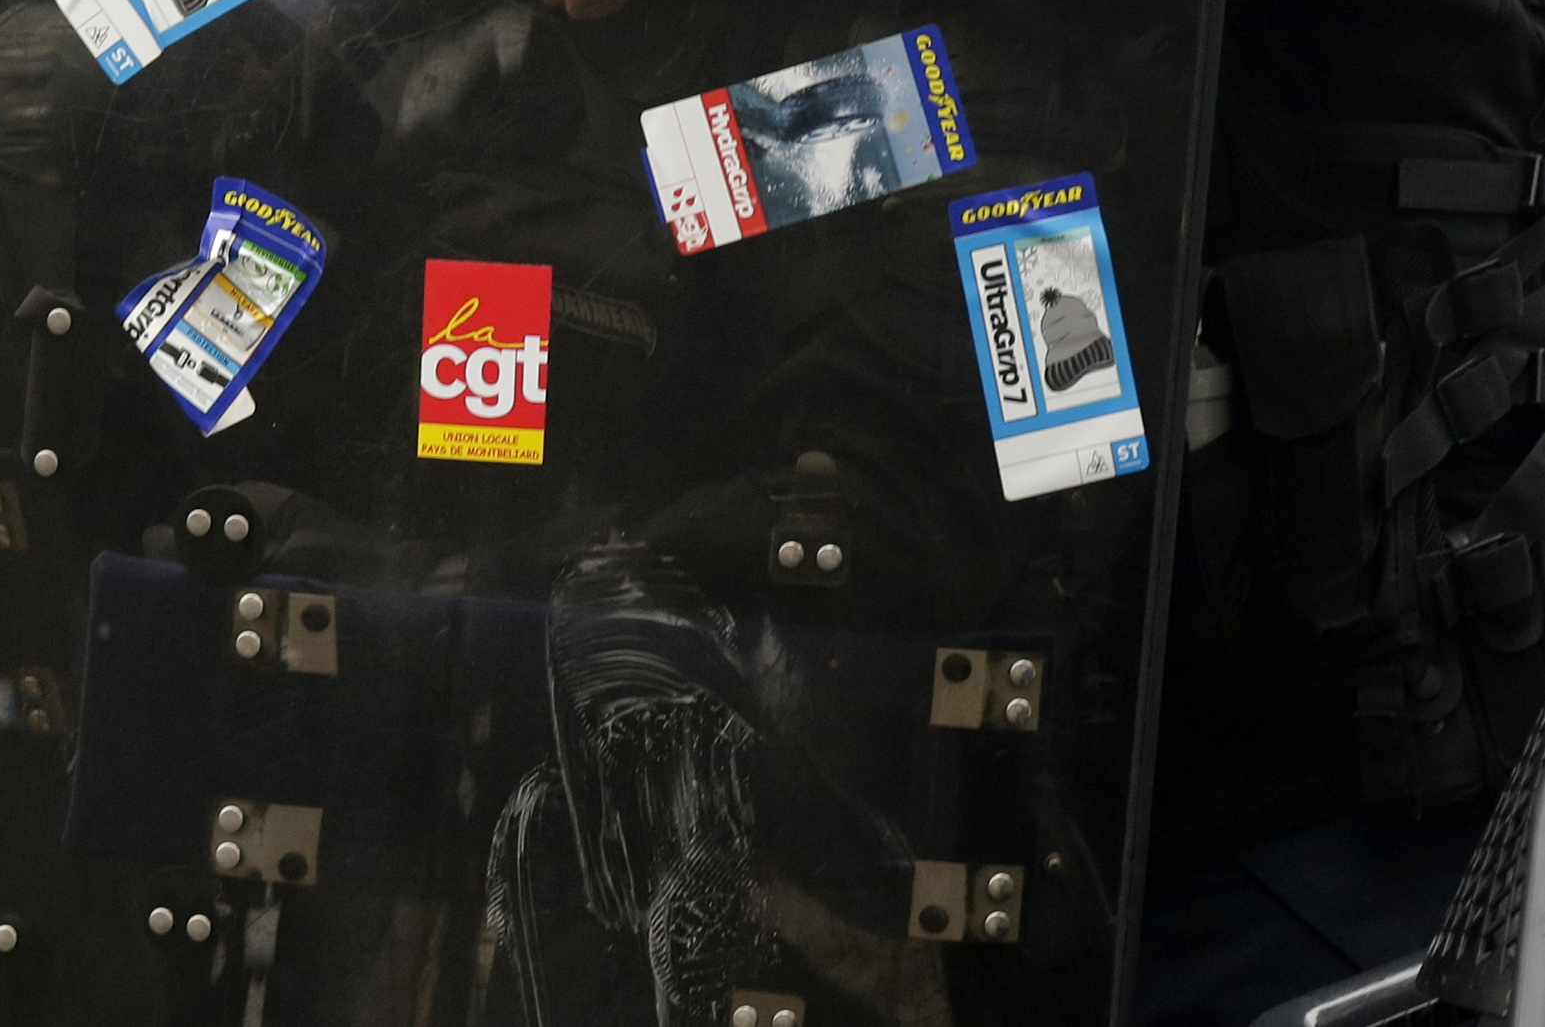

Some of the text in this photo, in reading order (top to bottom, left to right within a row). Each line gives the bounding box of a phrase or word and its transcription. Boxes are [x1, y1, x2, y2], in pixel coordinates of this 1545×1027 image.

[110, 46, 135, 72] ST
[915, 33, 965, 162] GOODYEAR
[708, 103, 755, 219] HydraGrip
[223, 190, 322, 252] GOODYEAR
[962, 185, 1084, 225] GOODYEAR
[429, 297, 522, 348] la
[979, 260, 1029, 404] UltraGrip 7
[185, 326, 231, 367] PROTECTION
[420, 335, 549, 419] cgt
[421, 443, 540, 461] PAYS DE MONTBELIARD
[442, 431, 518, 445] UNION LOCALE
[1116, 440, 1142, 462] ST
